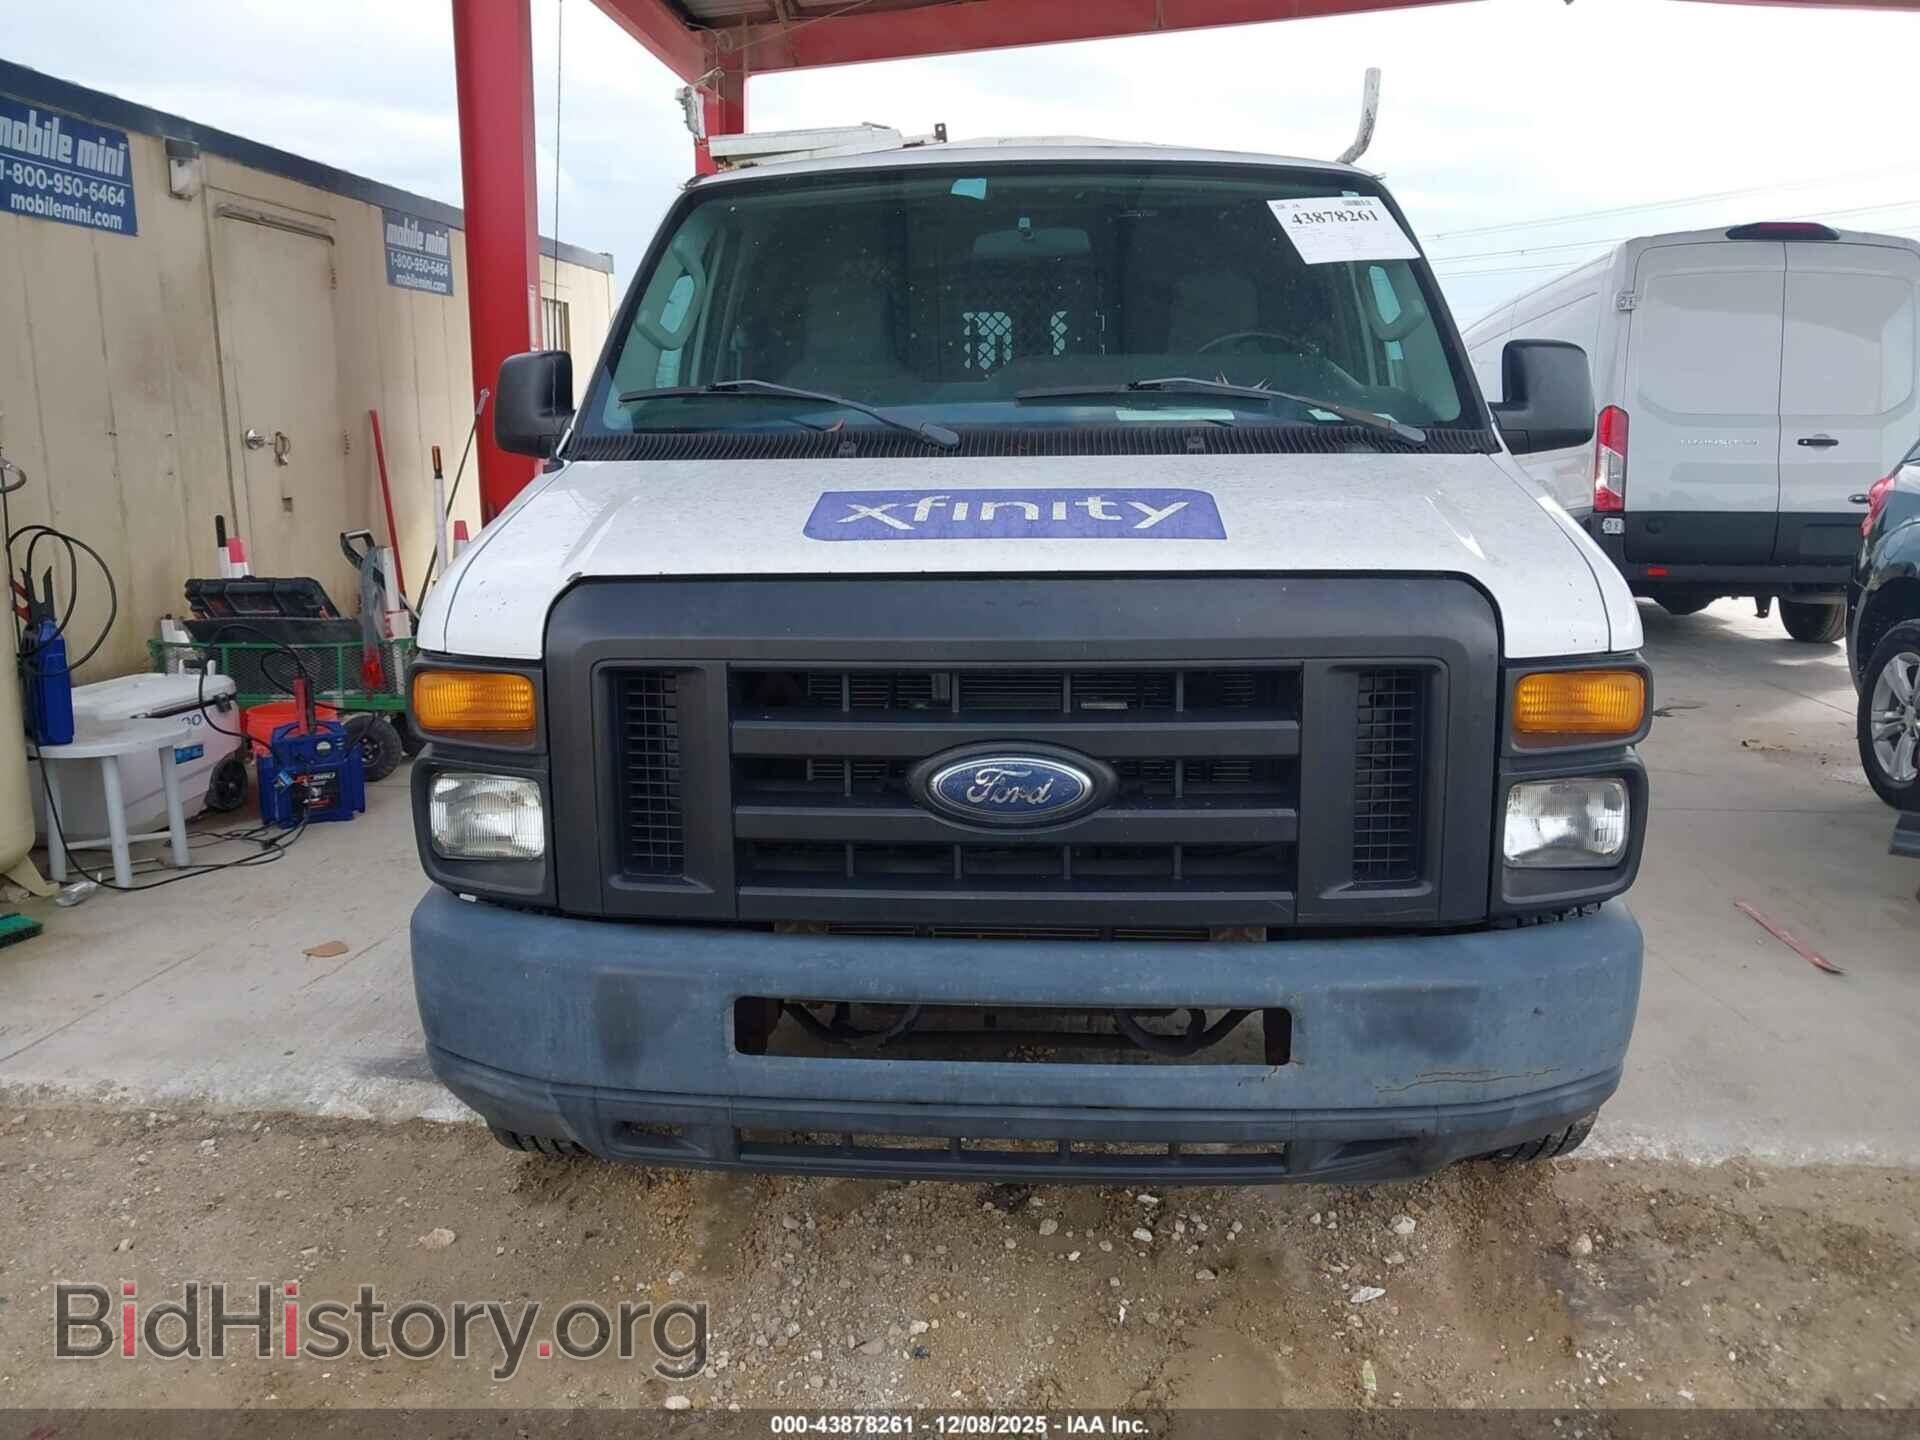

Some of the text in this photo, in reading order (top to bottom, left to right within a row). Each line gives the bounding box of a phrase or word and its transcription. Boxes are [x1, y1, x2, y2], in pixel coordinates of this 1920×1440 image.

[77, 137, 128, 177] mini
[0, 159, 126, 207] 1-800-950-6464
[11, 192, 122, 230] mobilemini.com
[1292, 209, 1378, 225] 43878261
[386, 217, 448, 256] mobile mini
[836, 495, 1189, 530] xfinity
[966, 767, 1054, 804] Ford
